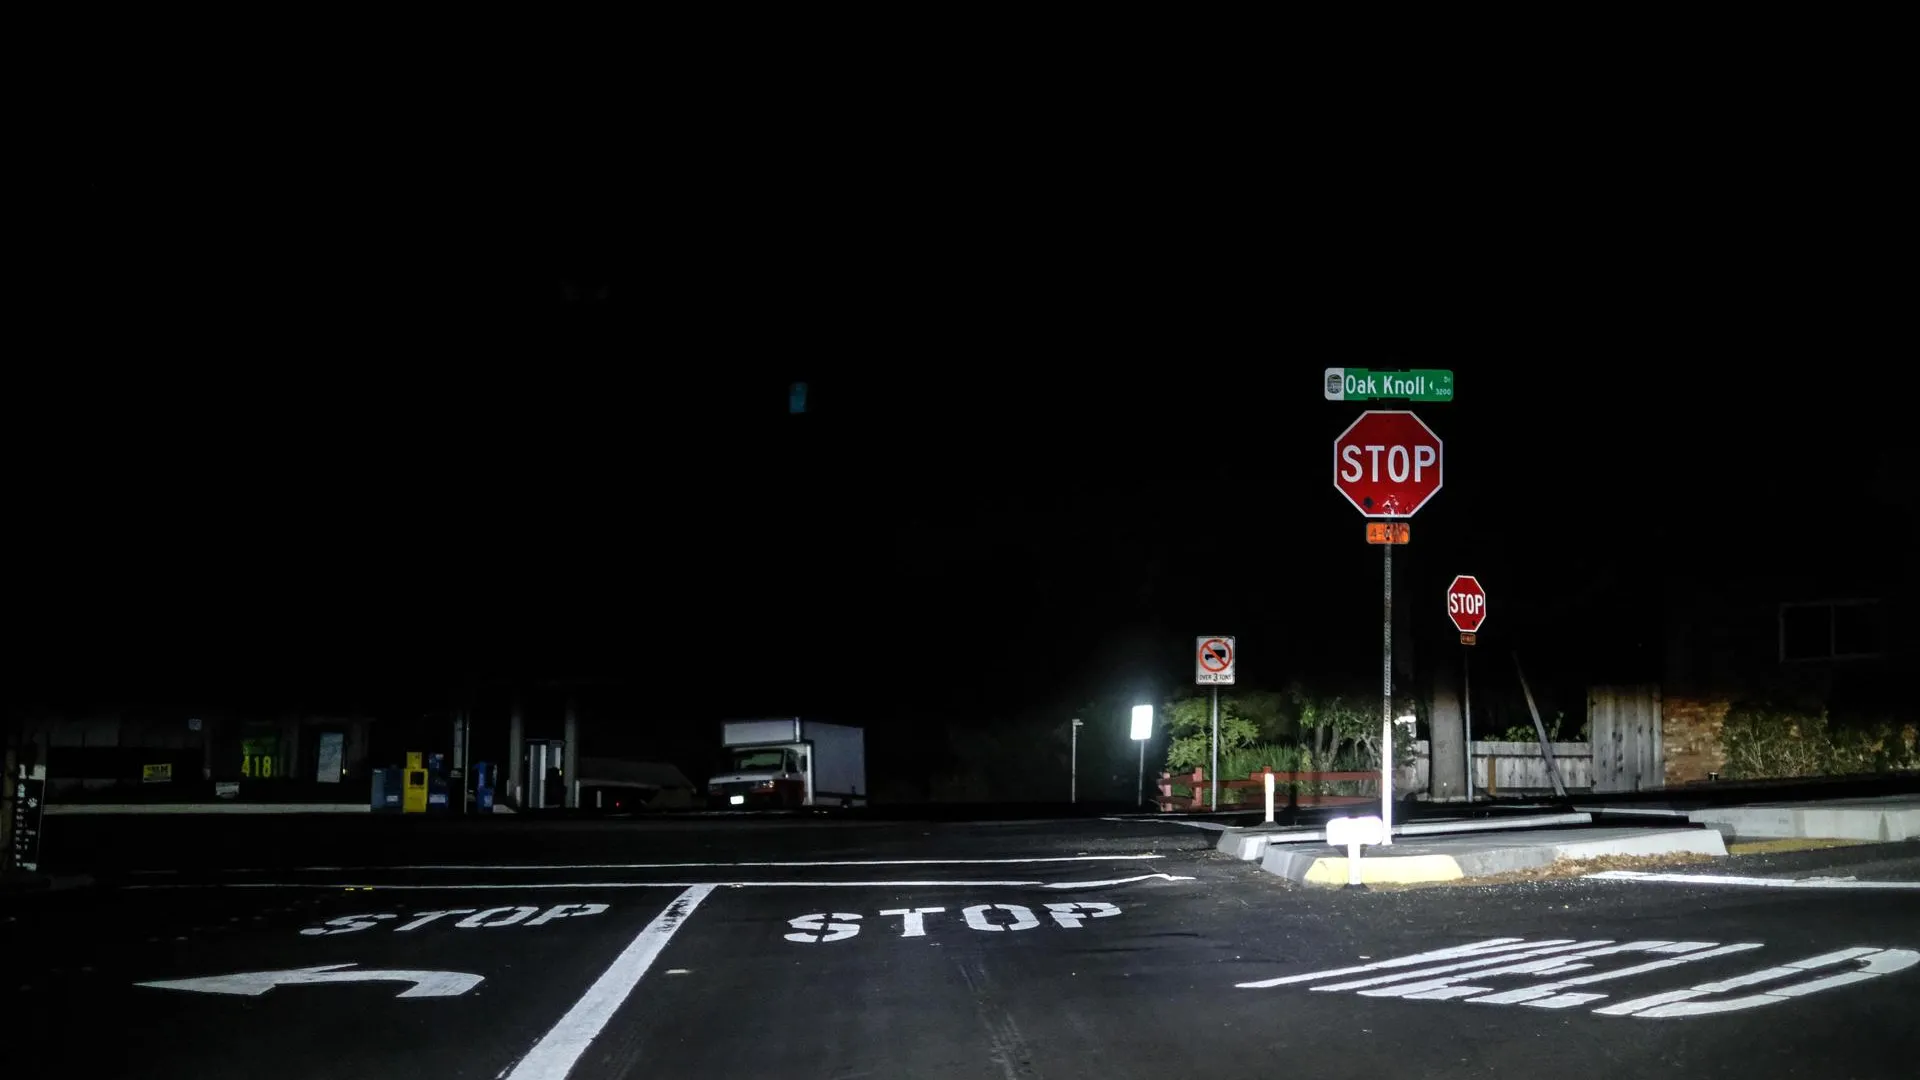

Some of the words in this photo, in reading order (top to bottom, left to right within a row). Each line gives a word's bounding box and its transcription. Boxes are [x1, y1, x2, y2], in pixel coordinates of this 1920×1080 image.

[1345, 374, 1377, 394] Oak
[1383, 375, 1425, 395] Knoll
[1341, 444, 1436, 483] STOP
[1450, 592, 1483, 614] STOP
[300, 903, 610, 935] STOP
[783, 902, 1122, 943] STOP
[1235, 937, 1919, 1018] YIELD
